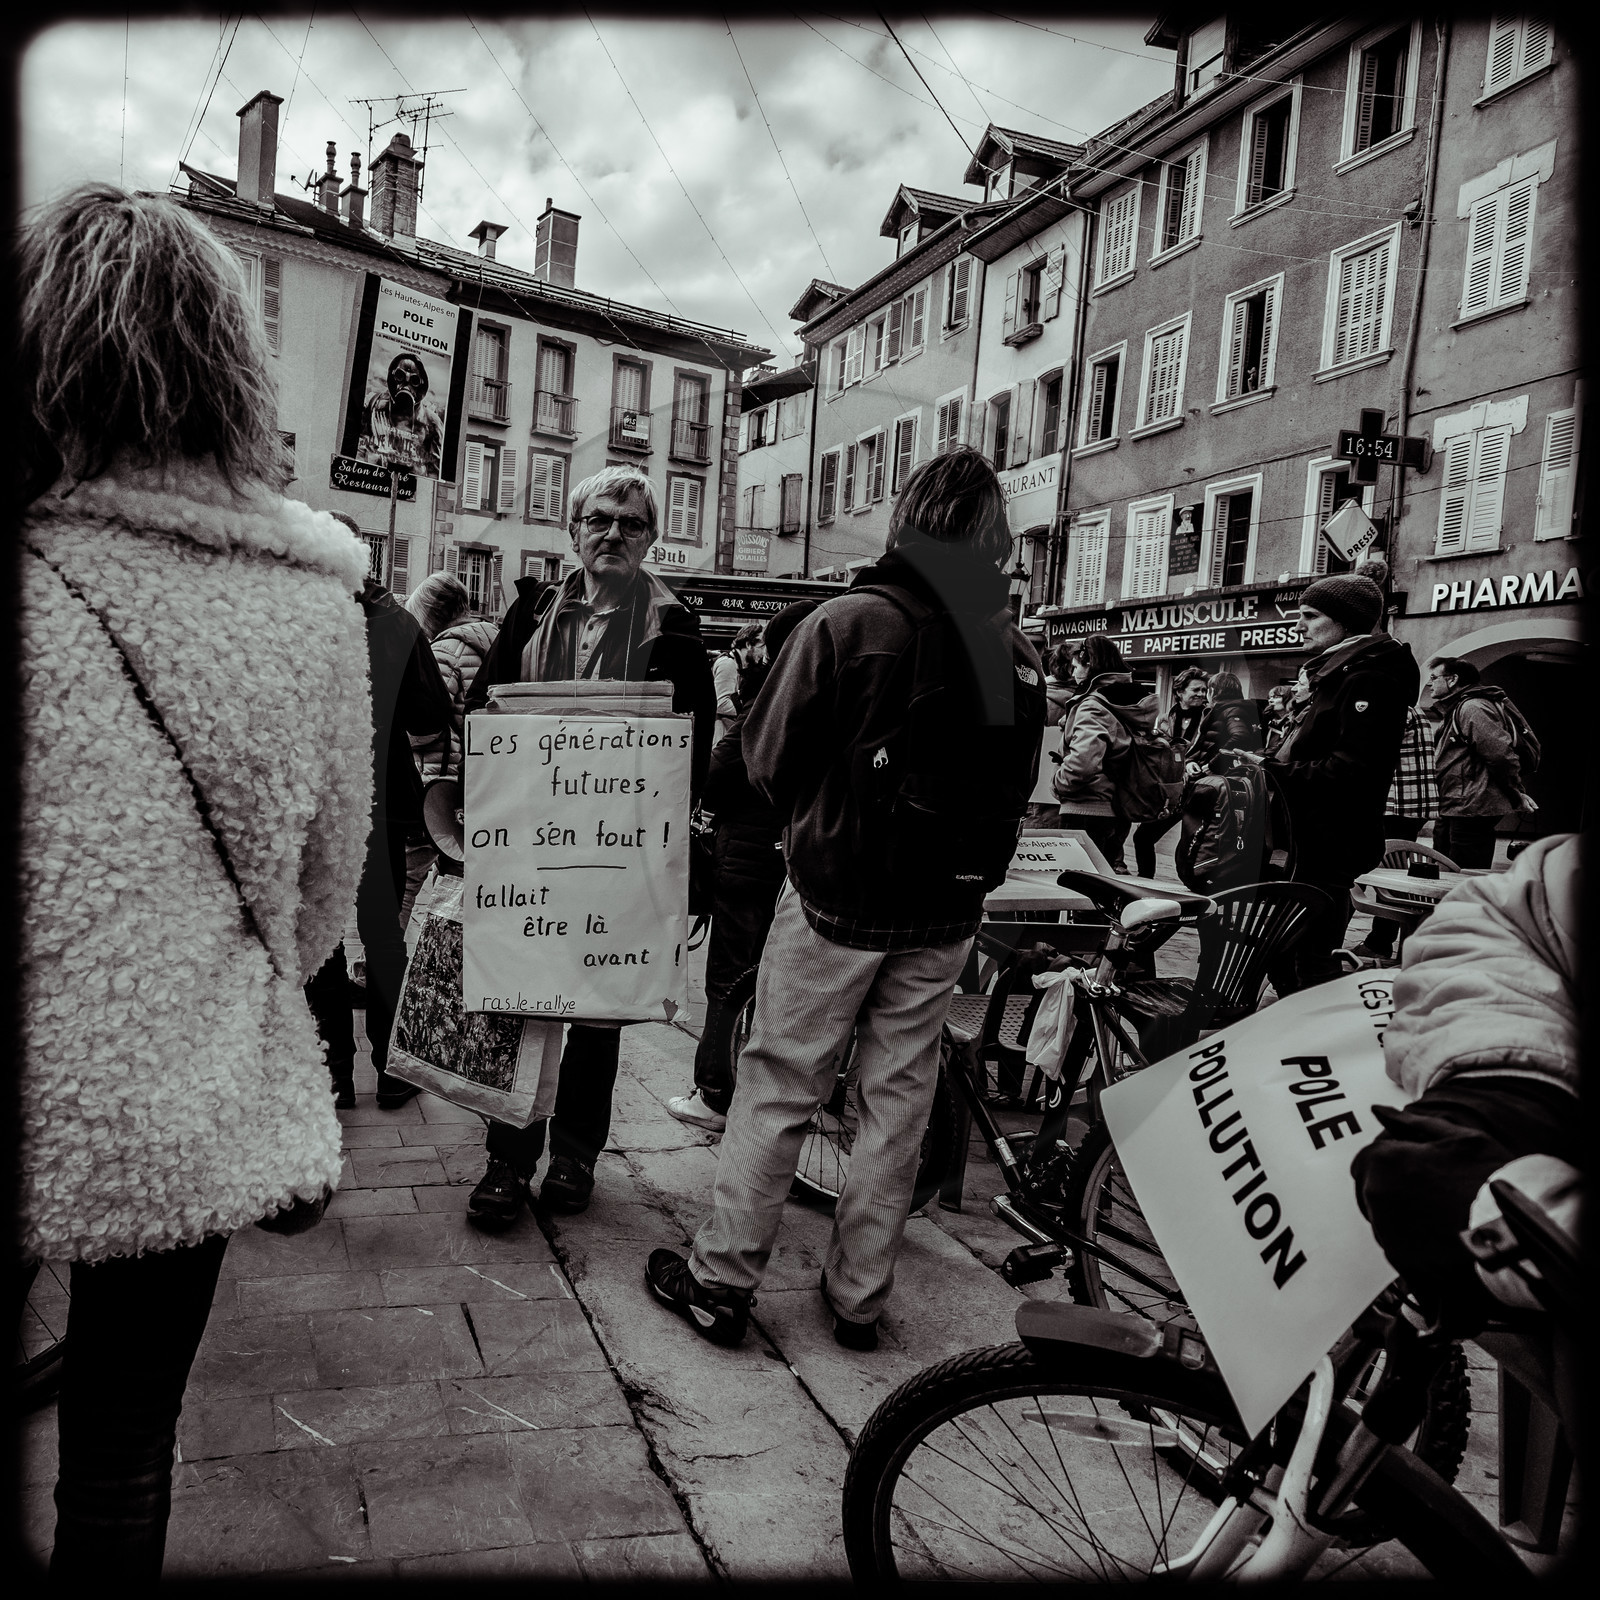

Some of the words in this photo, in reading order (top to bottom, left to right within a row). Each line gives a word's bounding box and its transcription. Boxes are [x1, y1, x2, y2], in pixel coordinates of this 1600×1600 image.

[380, 285, 393, 296] Les
[394, 290, 444, 314] Hautes-Alpes
[446, 310, 456, 318] en
[403, 310, 434, 328] POLE
[381, 321, 448, 351] POLLUTION
[1345, 437, 1393, 458] 16:54
[338, 459, 371, 476] Salon
[372, 466, 386, 478] de
[334, 472, 413, 496] Restauraon
[738, 547, 765, 555] GIBIERS
[1346, 526, 1376, 558] PRESSE
[650, 546, 686, 563] Pub
[735, 554, 767, 562] VOLAILLES
[721, 598, 745, 610] BAR
[1052, 618, 1108, 636] DAVAGNIER
[1120, 595, 1259, 633] MAJUSCULE
[1143, 632, 1226, 653] PAPETERIE
[466, 720, 518, 756] Les
[538, 724, 690, 765] générations
[551, 766, 660, 798] futures,
[471, 827, 510, 848] on
[596, 820, 646, 848] fout
[663, 821, 670, 849] !
[1016, 853, 1056, 862] POLE
[476, 884, 550, 909] fallait
[523, 916, 568, 937] être
[585, 914, 609, 934] là
[583, 949, 650, 967] avant
[674, 944, 682, 967] !
[1280, 1055, 1363, 1150] POLE
[1188, 1040, 1307, 1290] POLLUTION
